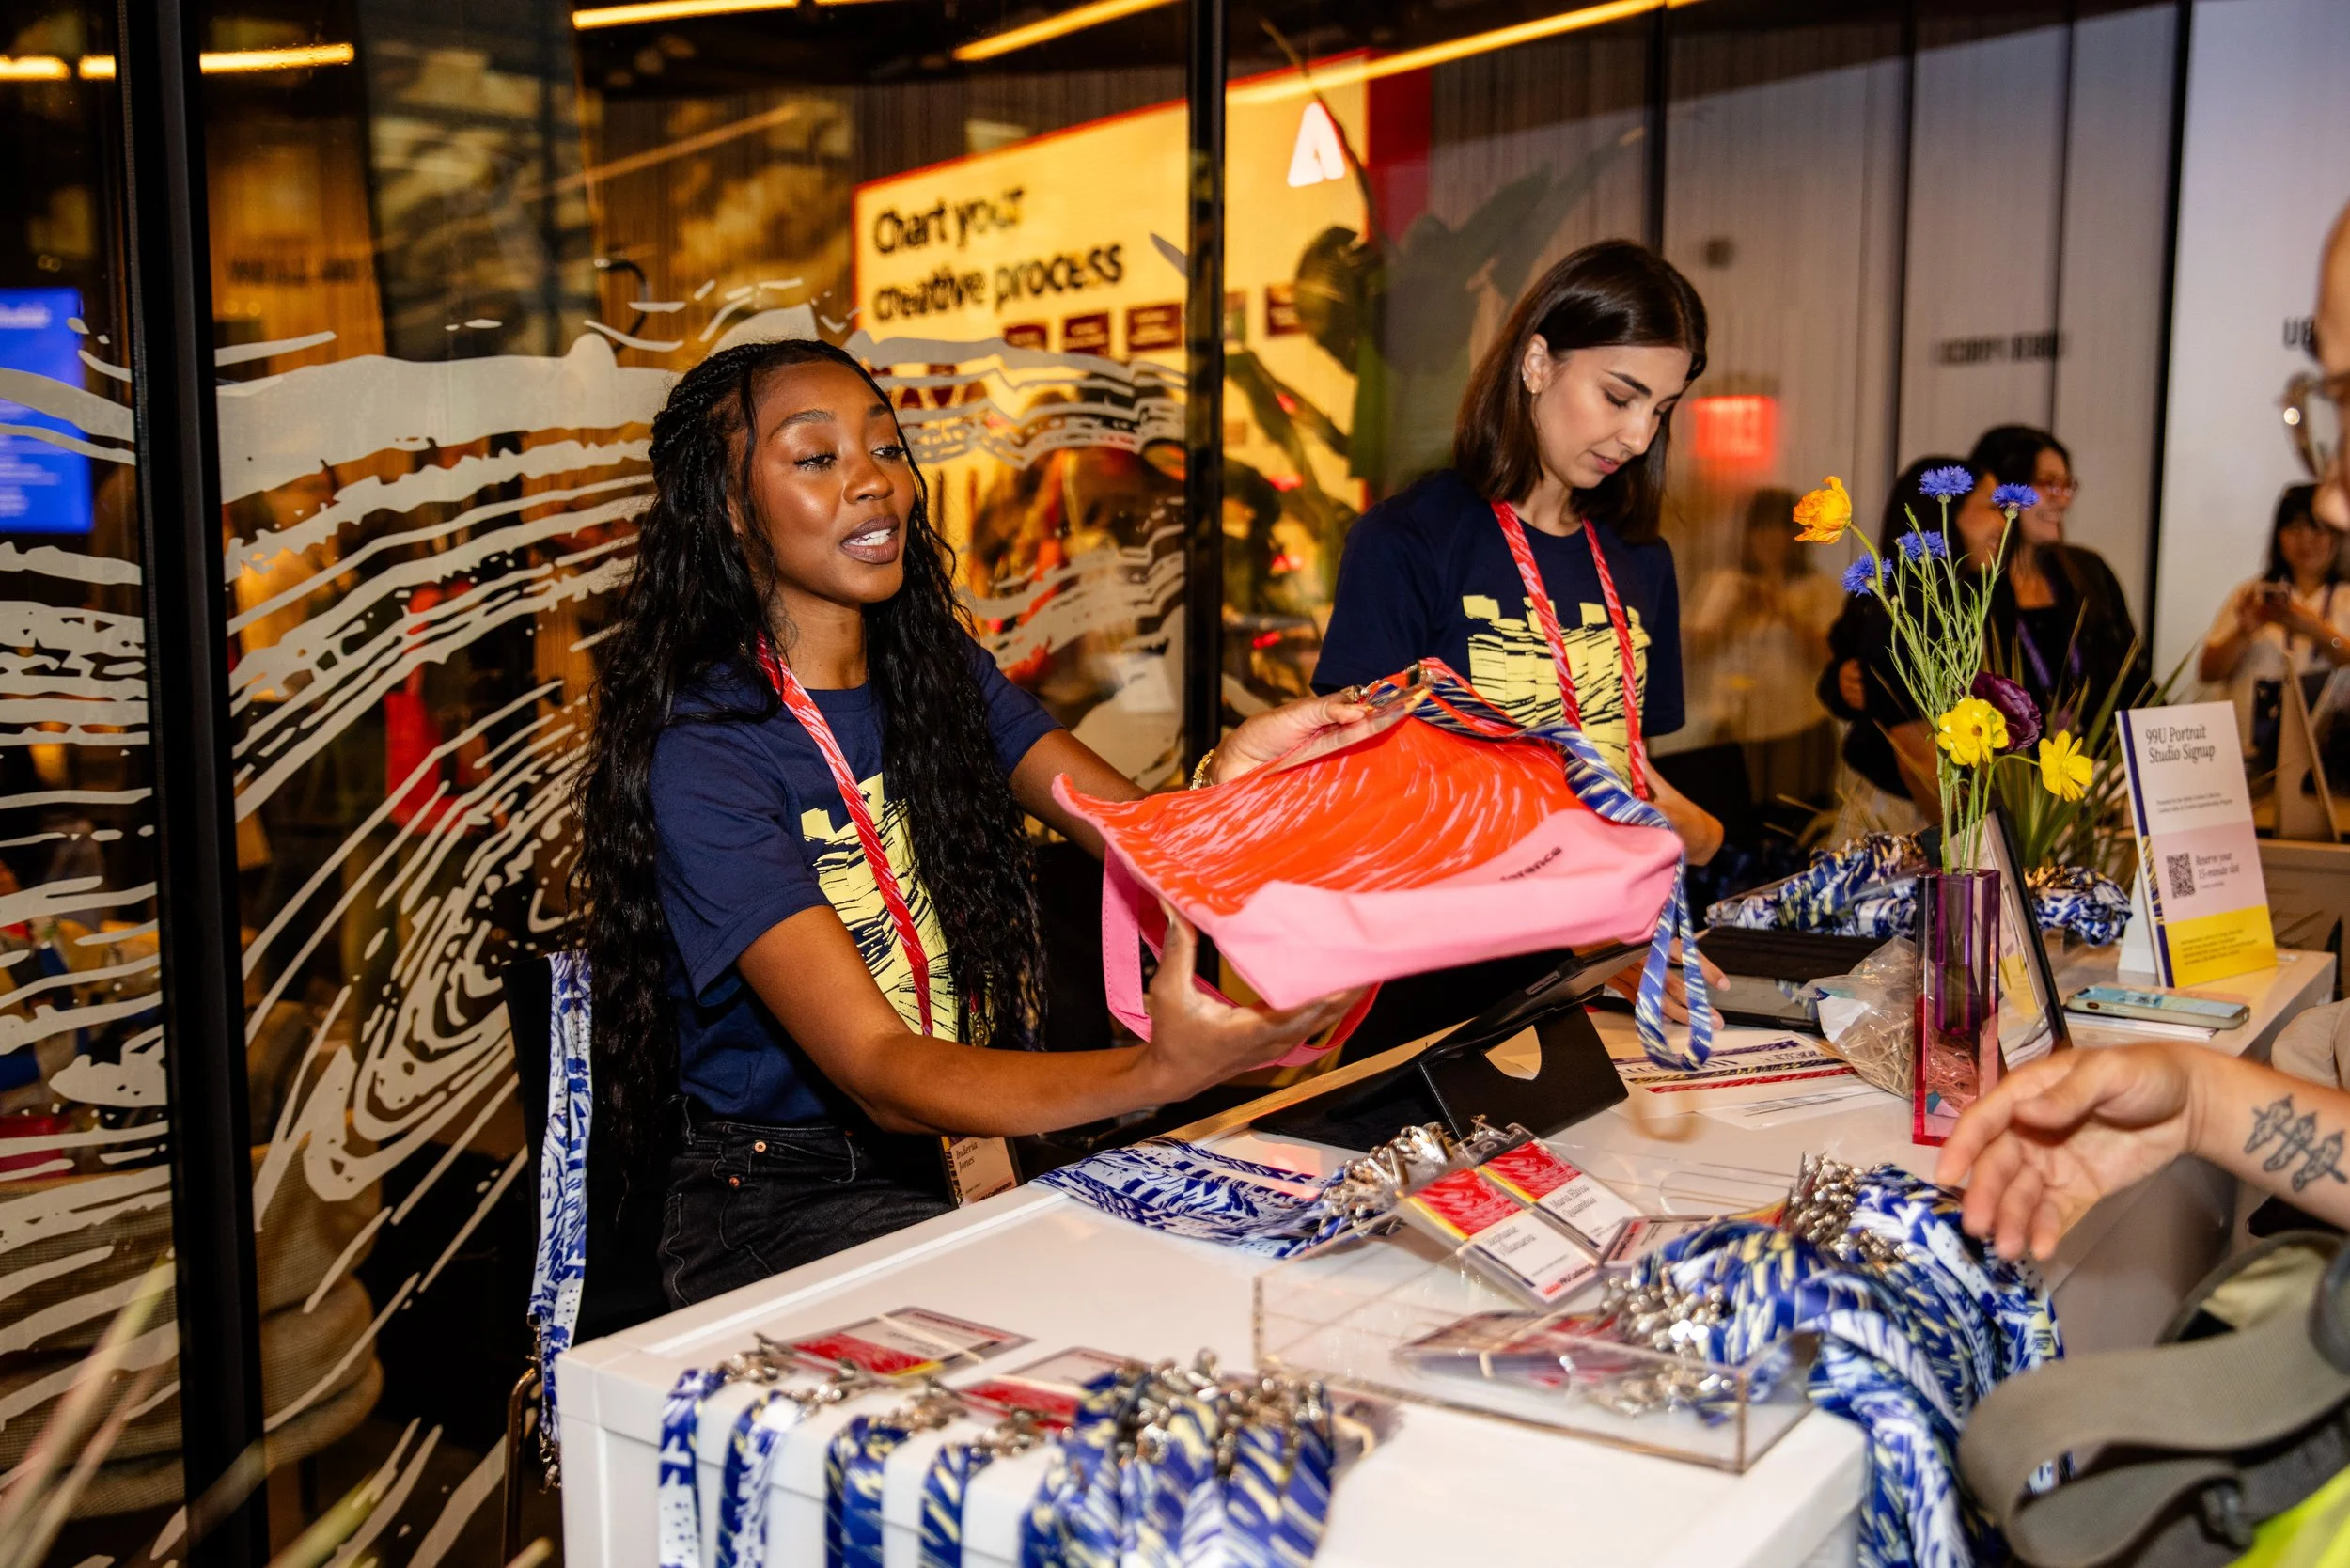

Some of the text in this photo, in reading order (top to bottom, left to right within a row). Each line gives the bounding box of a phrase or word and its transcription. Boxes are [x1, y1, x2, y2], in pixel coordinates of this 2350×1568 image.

[873, 197, 948, 255] Chart
[873, 242, 1124, 322] creative process
[2146, 723, 2206, 745] 99U Portrait
[2149, 743, 2215, 764] Studio Signup
[958, 1156, 975, 1172] Jones
